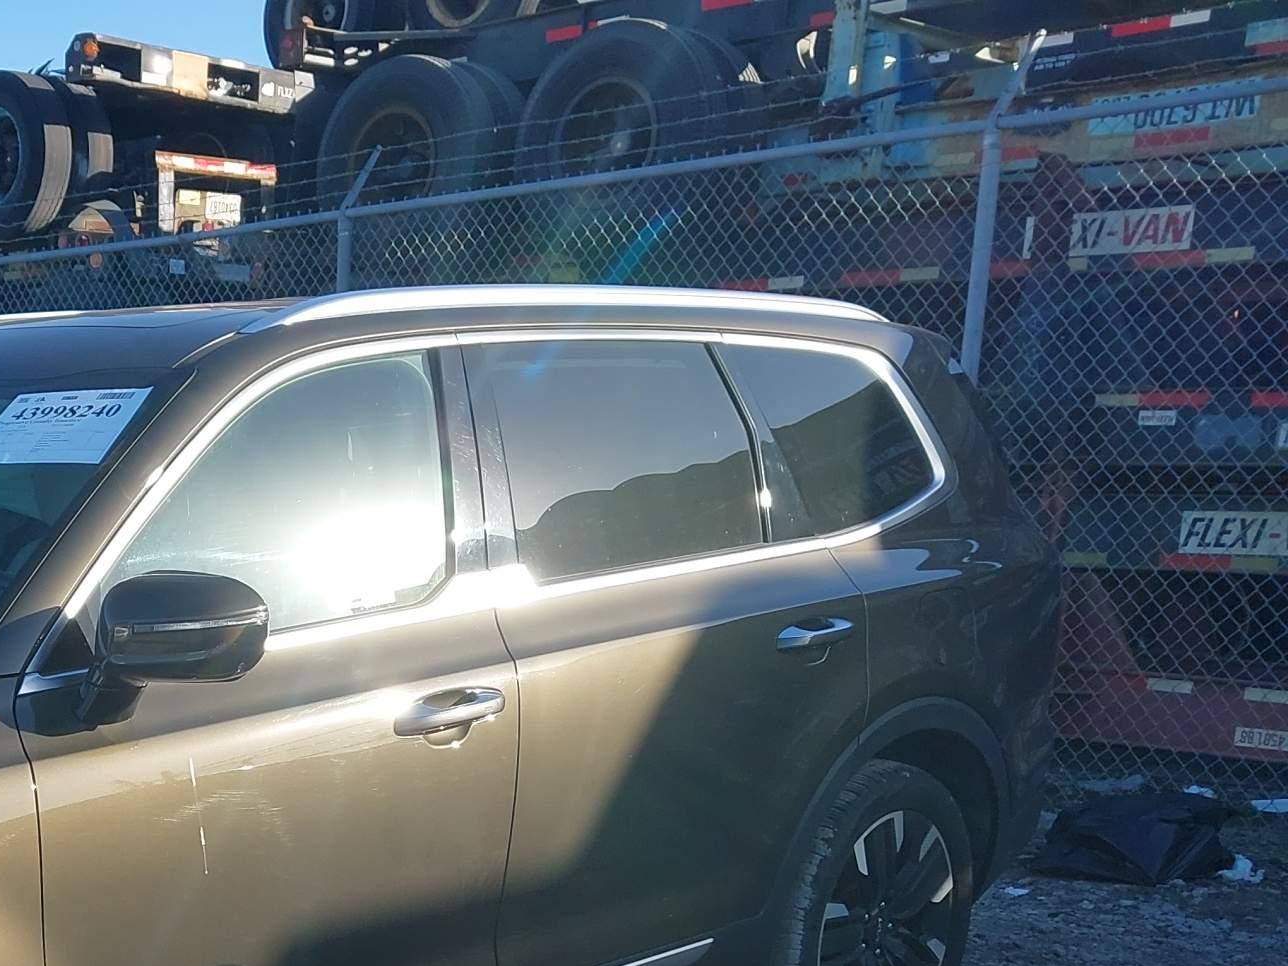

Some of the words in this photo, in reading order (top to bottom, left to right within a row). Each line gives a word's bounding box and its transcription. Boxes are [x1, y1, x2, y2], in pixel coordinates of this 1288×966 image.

[1072, 210, 1192, 250] XI-VAN
[12, 403, 122, 421] 43998240
[1181, 516, 1288, 549] FLEXI-
